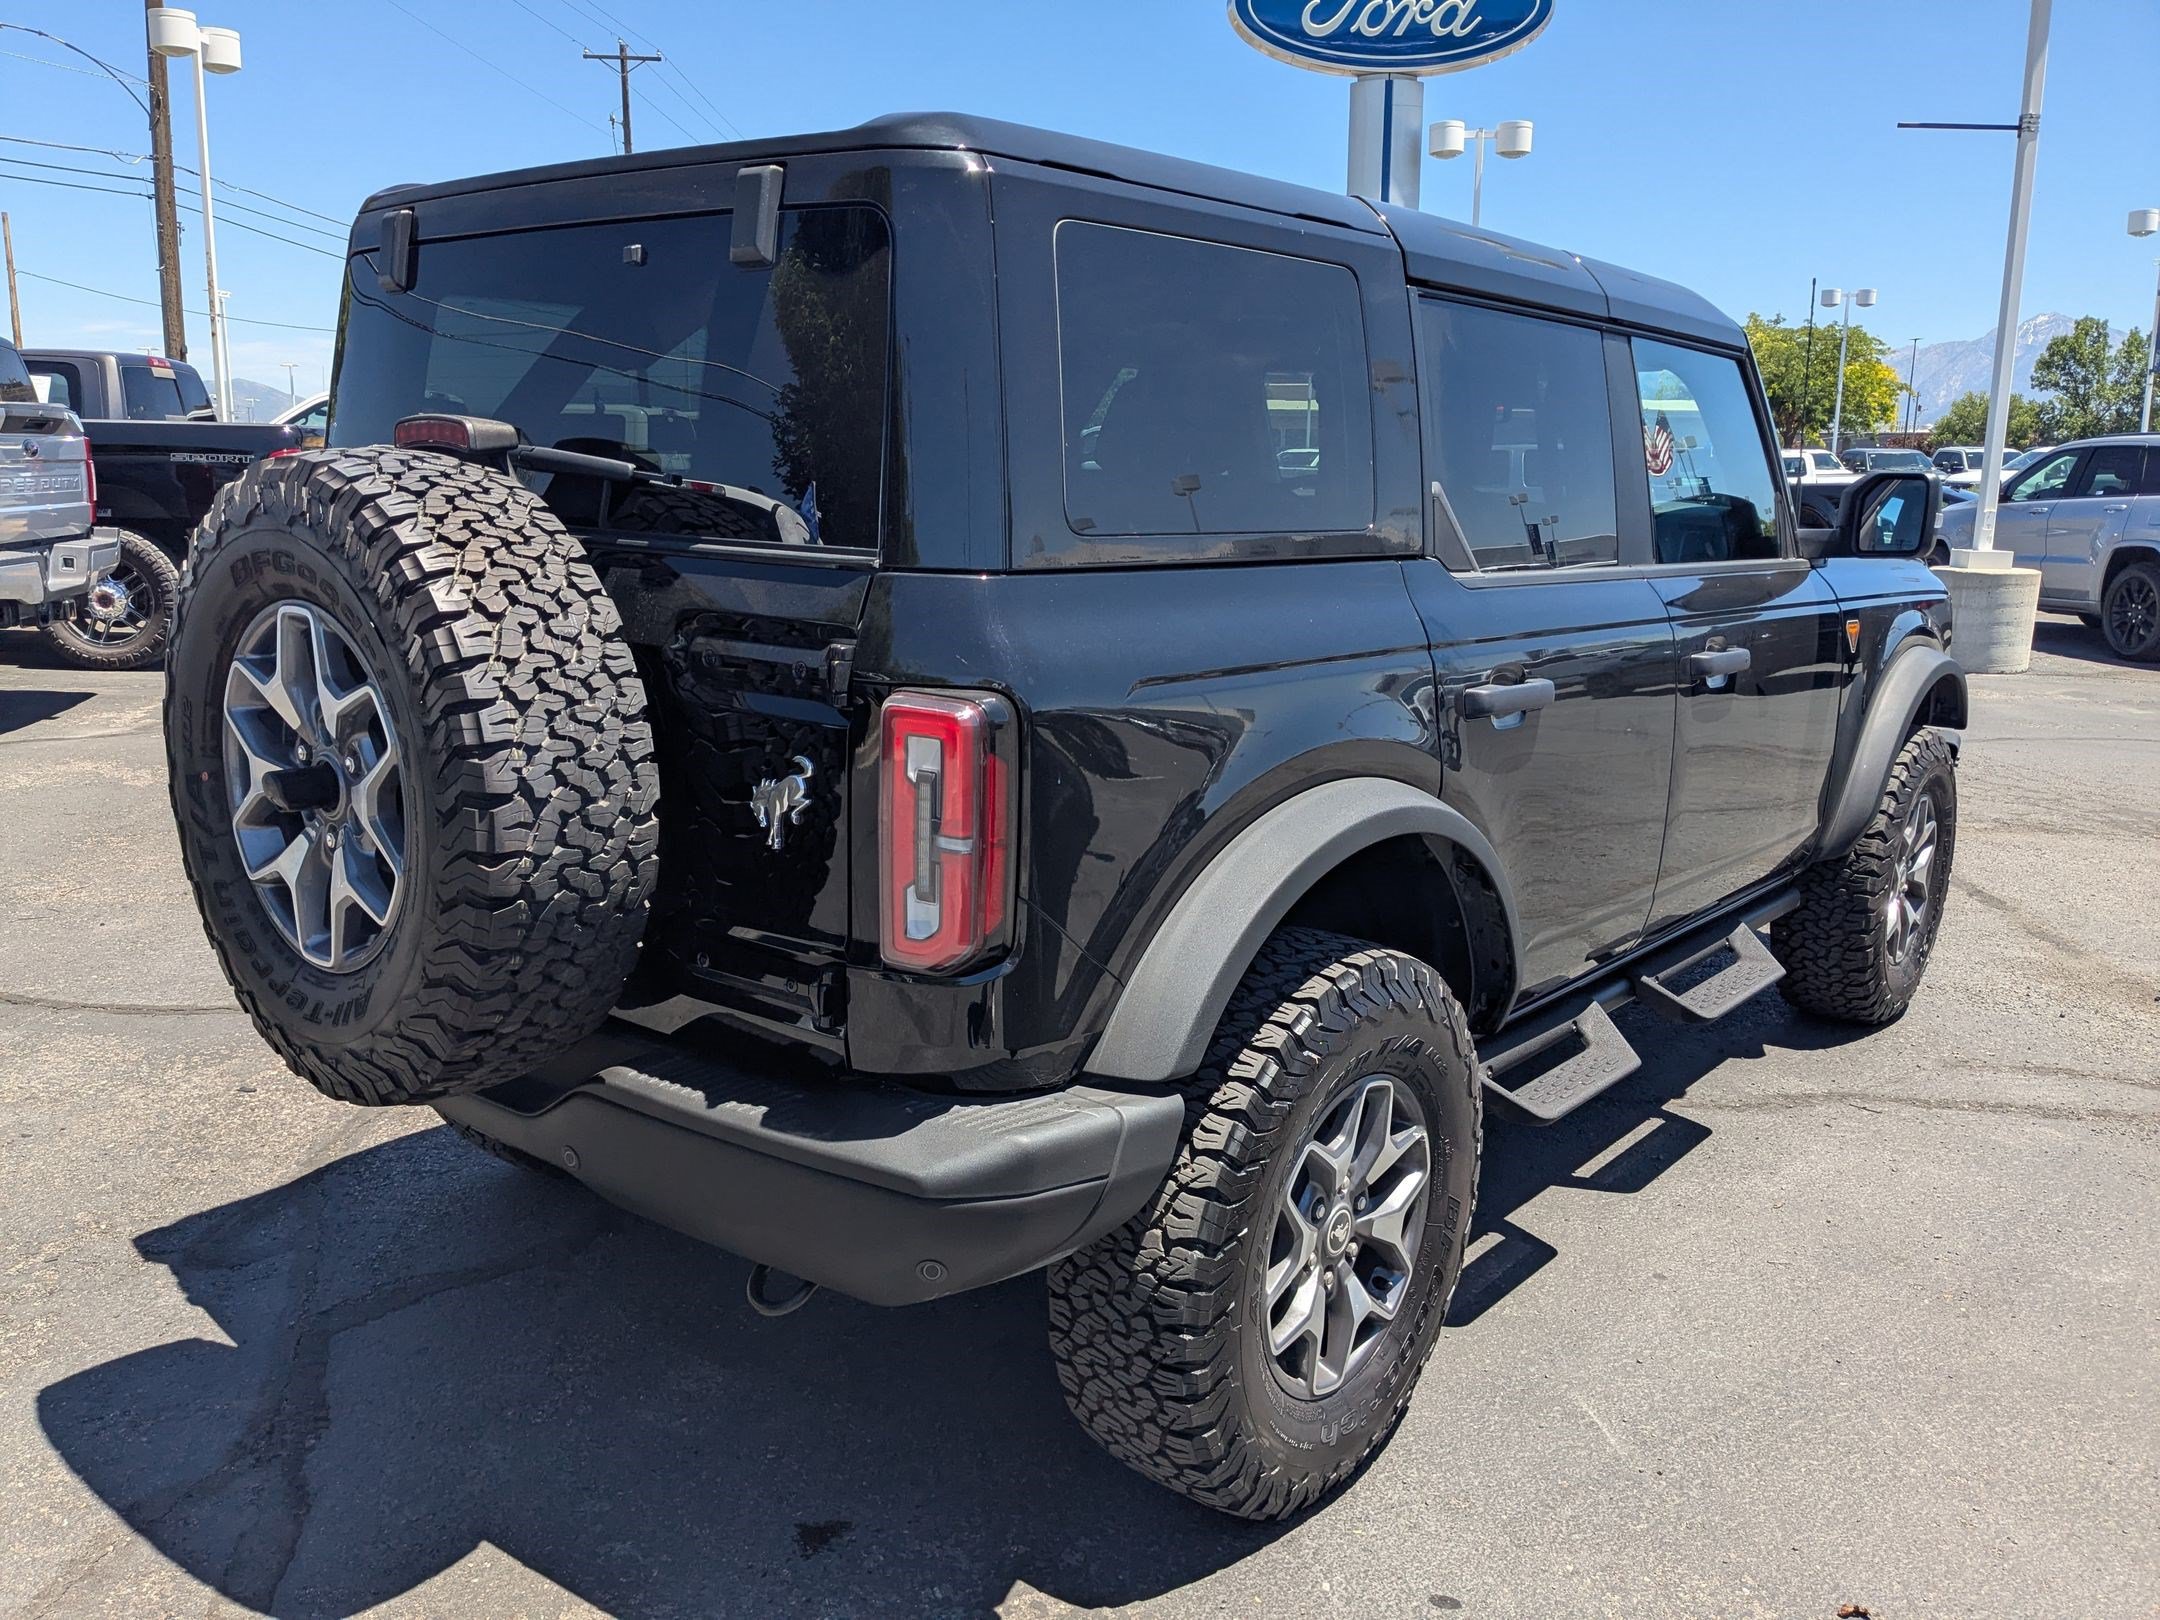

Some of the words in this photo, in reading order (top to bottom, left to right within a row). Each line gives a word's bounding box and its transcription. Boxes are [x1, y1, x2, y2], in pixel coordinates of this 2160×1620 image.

[170, 453, 254, 464] SPORT
[40, 477, 80, 489] DUTY
[1320, 1195, 1461, 1446] BFGoodrich
